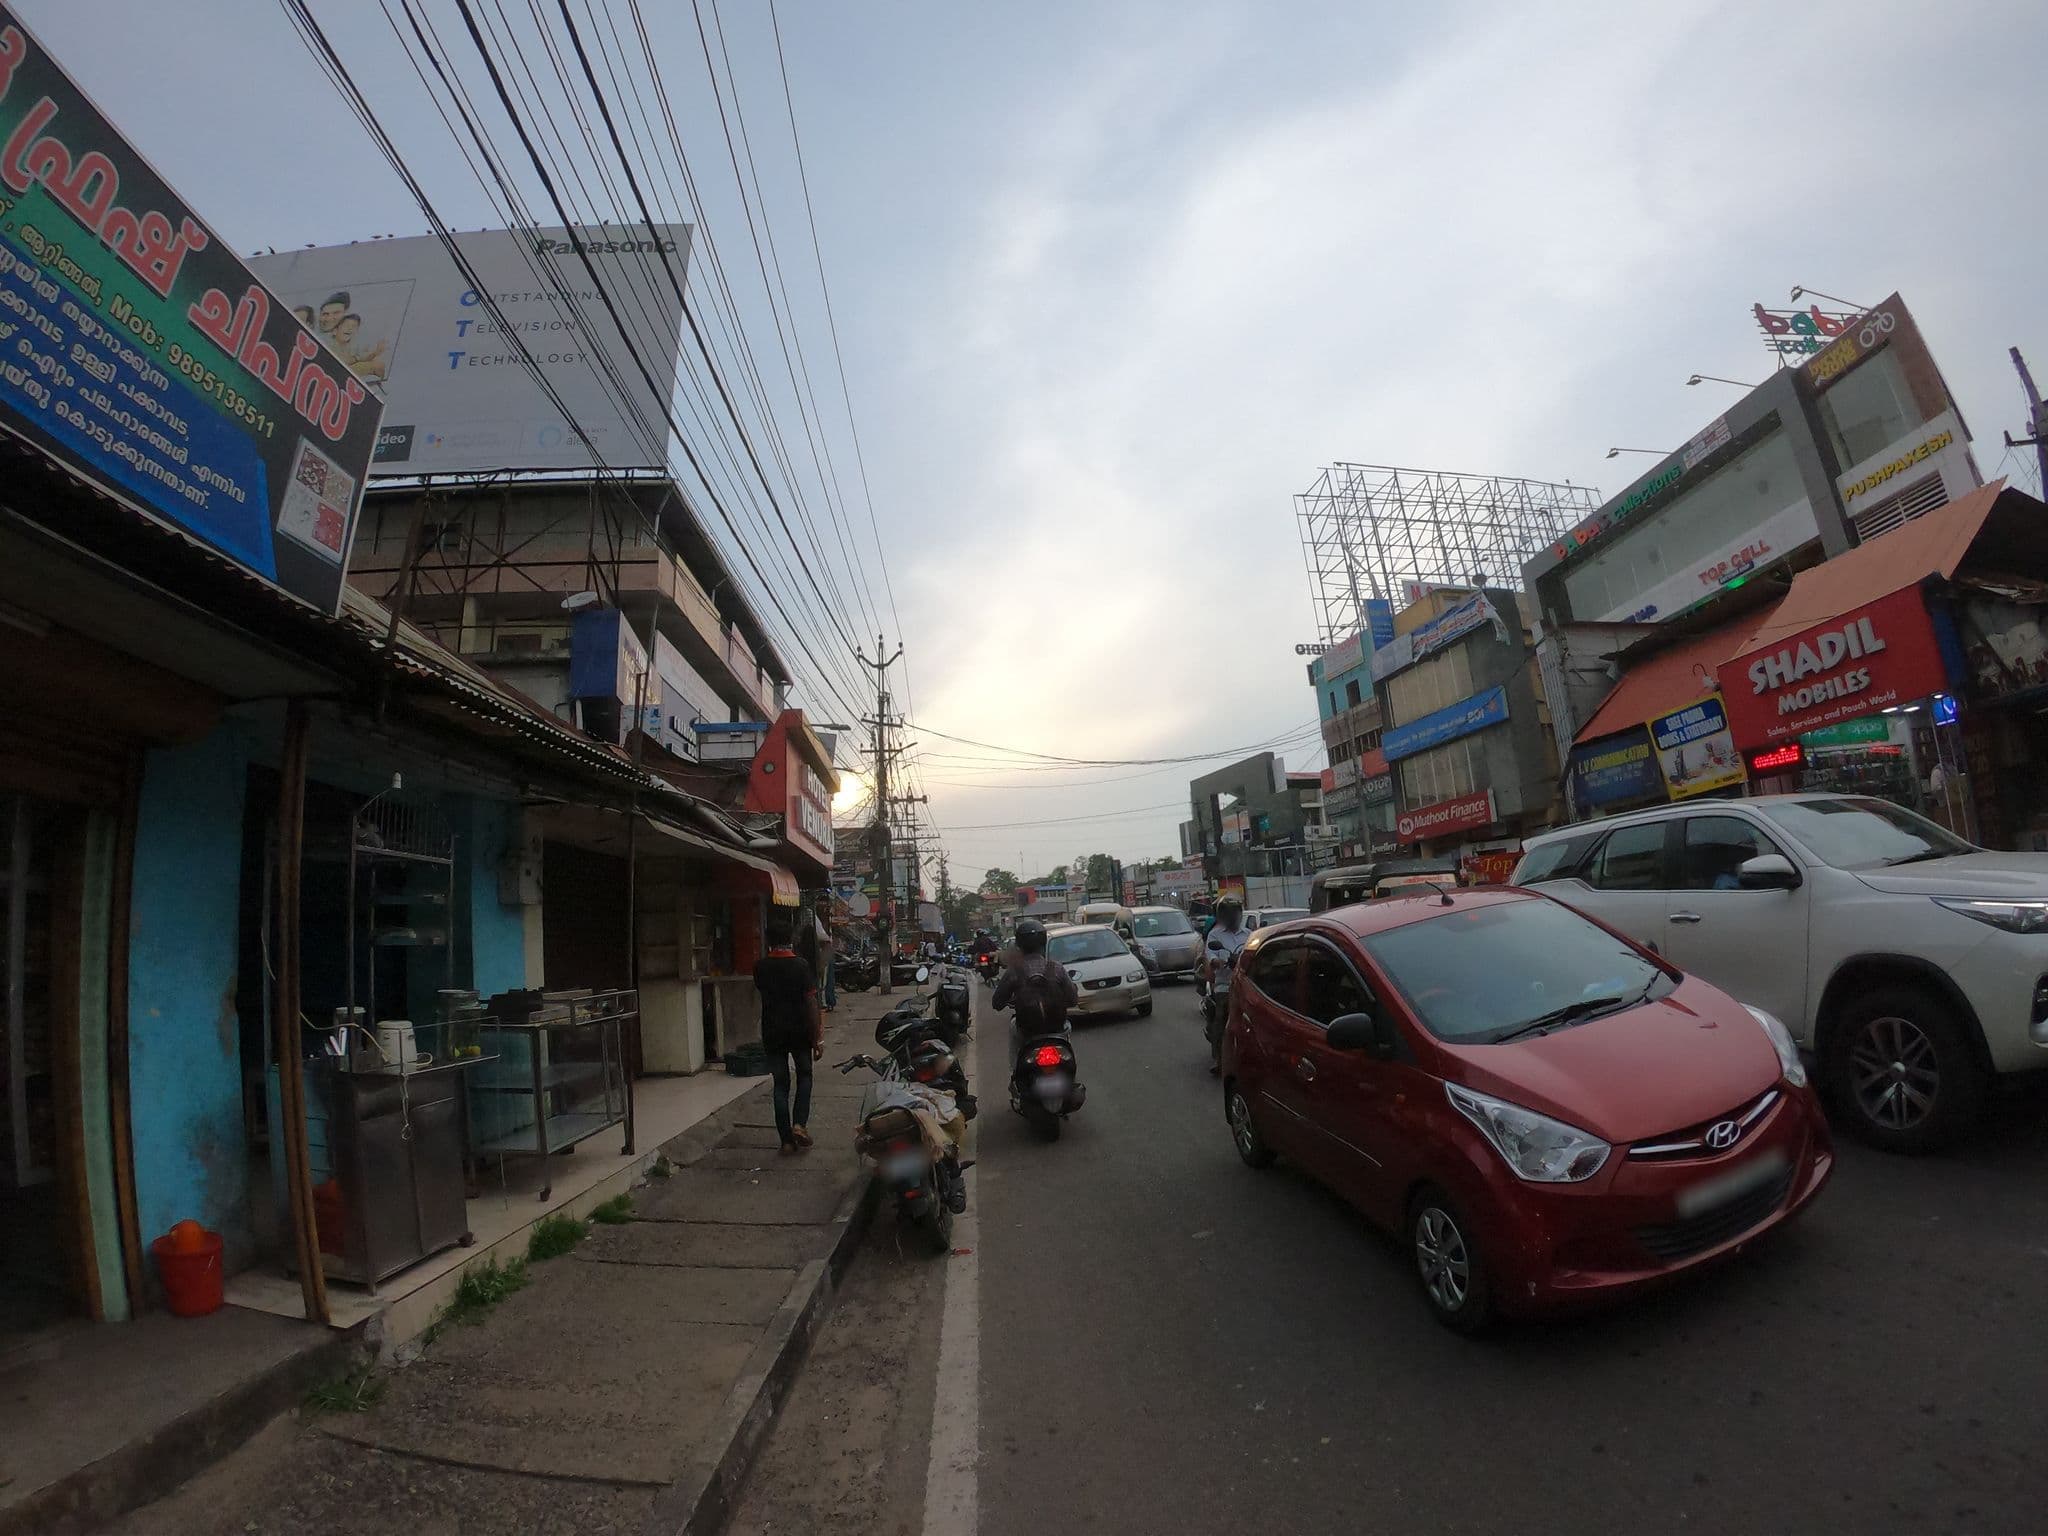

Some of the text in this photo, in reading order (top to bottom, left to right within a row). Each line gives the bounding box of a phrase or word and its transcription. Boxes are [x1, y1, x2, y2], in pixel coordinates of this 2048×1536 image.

[537, 238, 678, 256] Panasonic
[110, 294, 165, 352] Mob:
[168, 343, 275, 439] 9895138511
[447, 351, 588, 370] TECHNOLOGY
[1845, 429, 1954, 502] PUSHPAKESH
[1697, 561, 1729, 586] TOP
[1730, 539, 1772, 569] CELL
[1747, 616, 1887, 695] SHADIL
[1777, 666, 1872, 716] MOBILES
[1823, 709, 1841, 721] and
[1868, 688, 1897, 706] World
[1414, 808, 1449, 829] Muthoot
[1450, 799, 1486, 819] Finance
